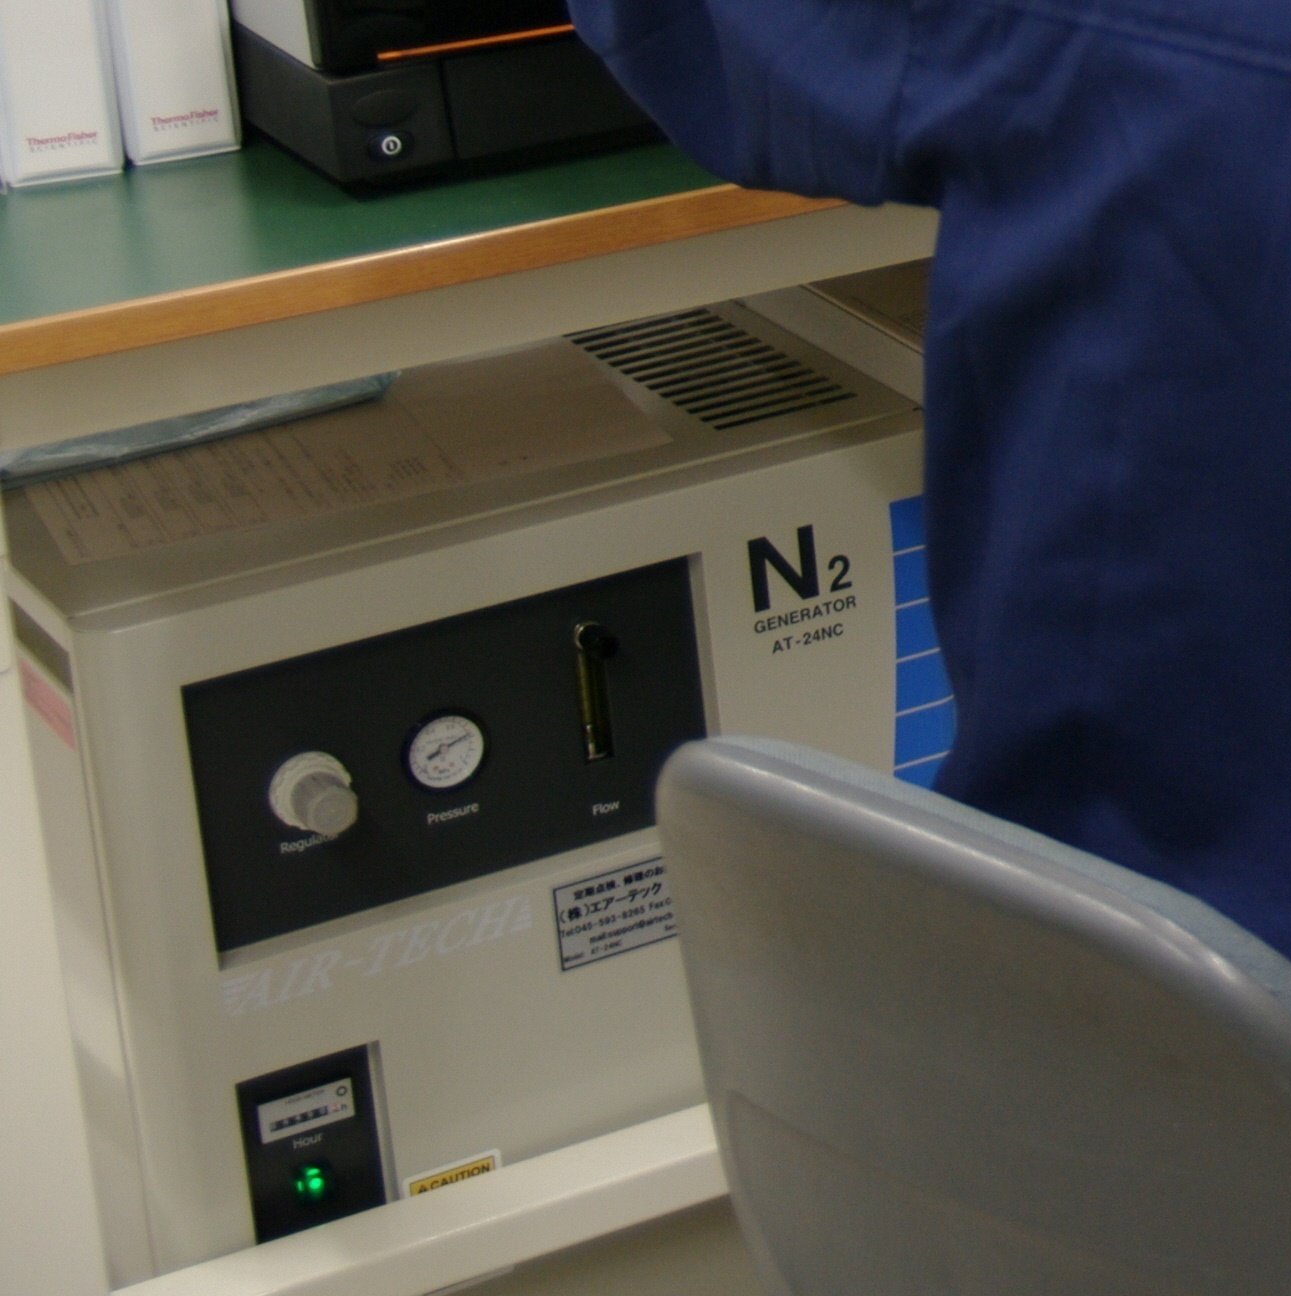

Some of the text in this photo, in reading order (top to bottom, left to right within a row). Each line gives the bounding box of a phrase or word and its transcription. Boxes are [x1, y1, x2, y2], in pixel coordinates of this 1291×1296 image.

[753, 595, 857, 635] GENERATOR
[772, 622, 845, 655] AT-24NC
[426, 801, 480, 826] Pressure
[591, 799, 620, 817] Flow
[292, 1131, 325, 1151] Hour
[429, 1161, 491, 1193] CAUTION
